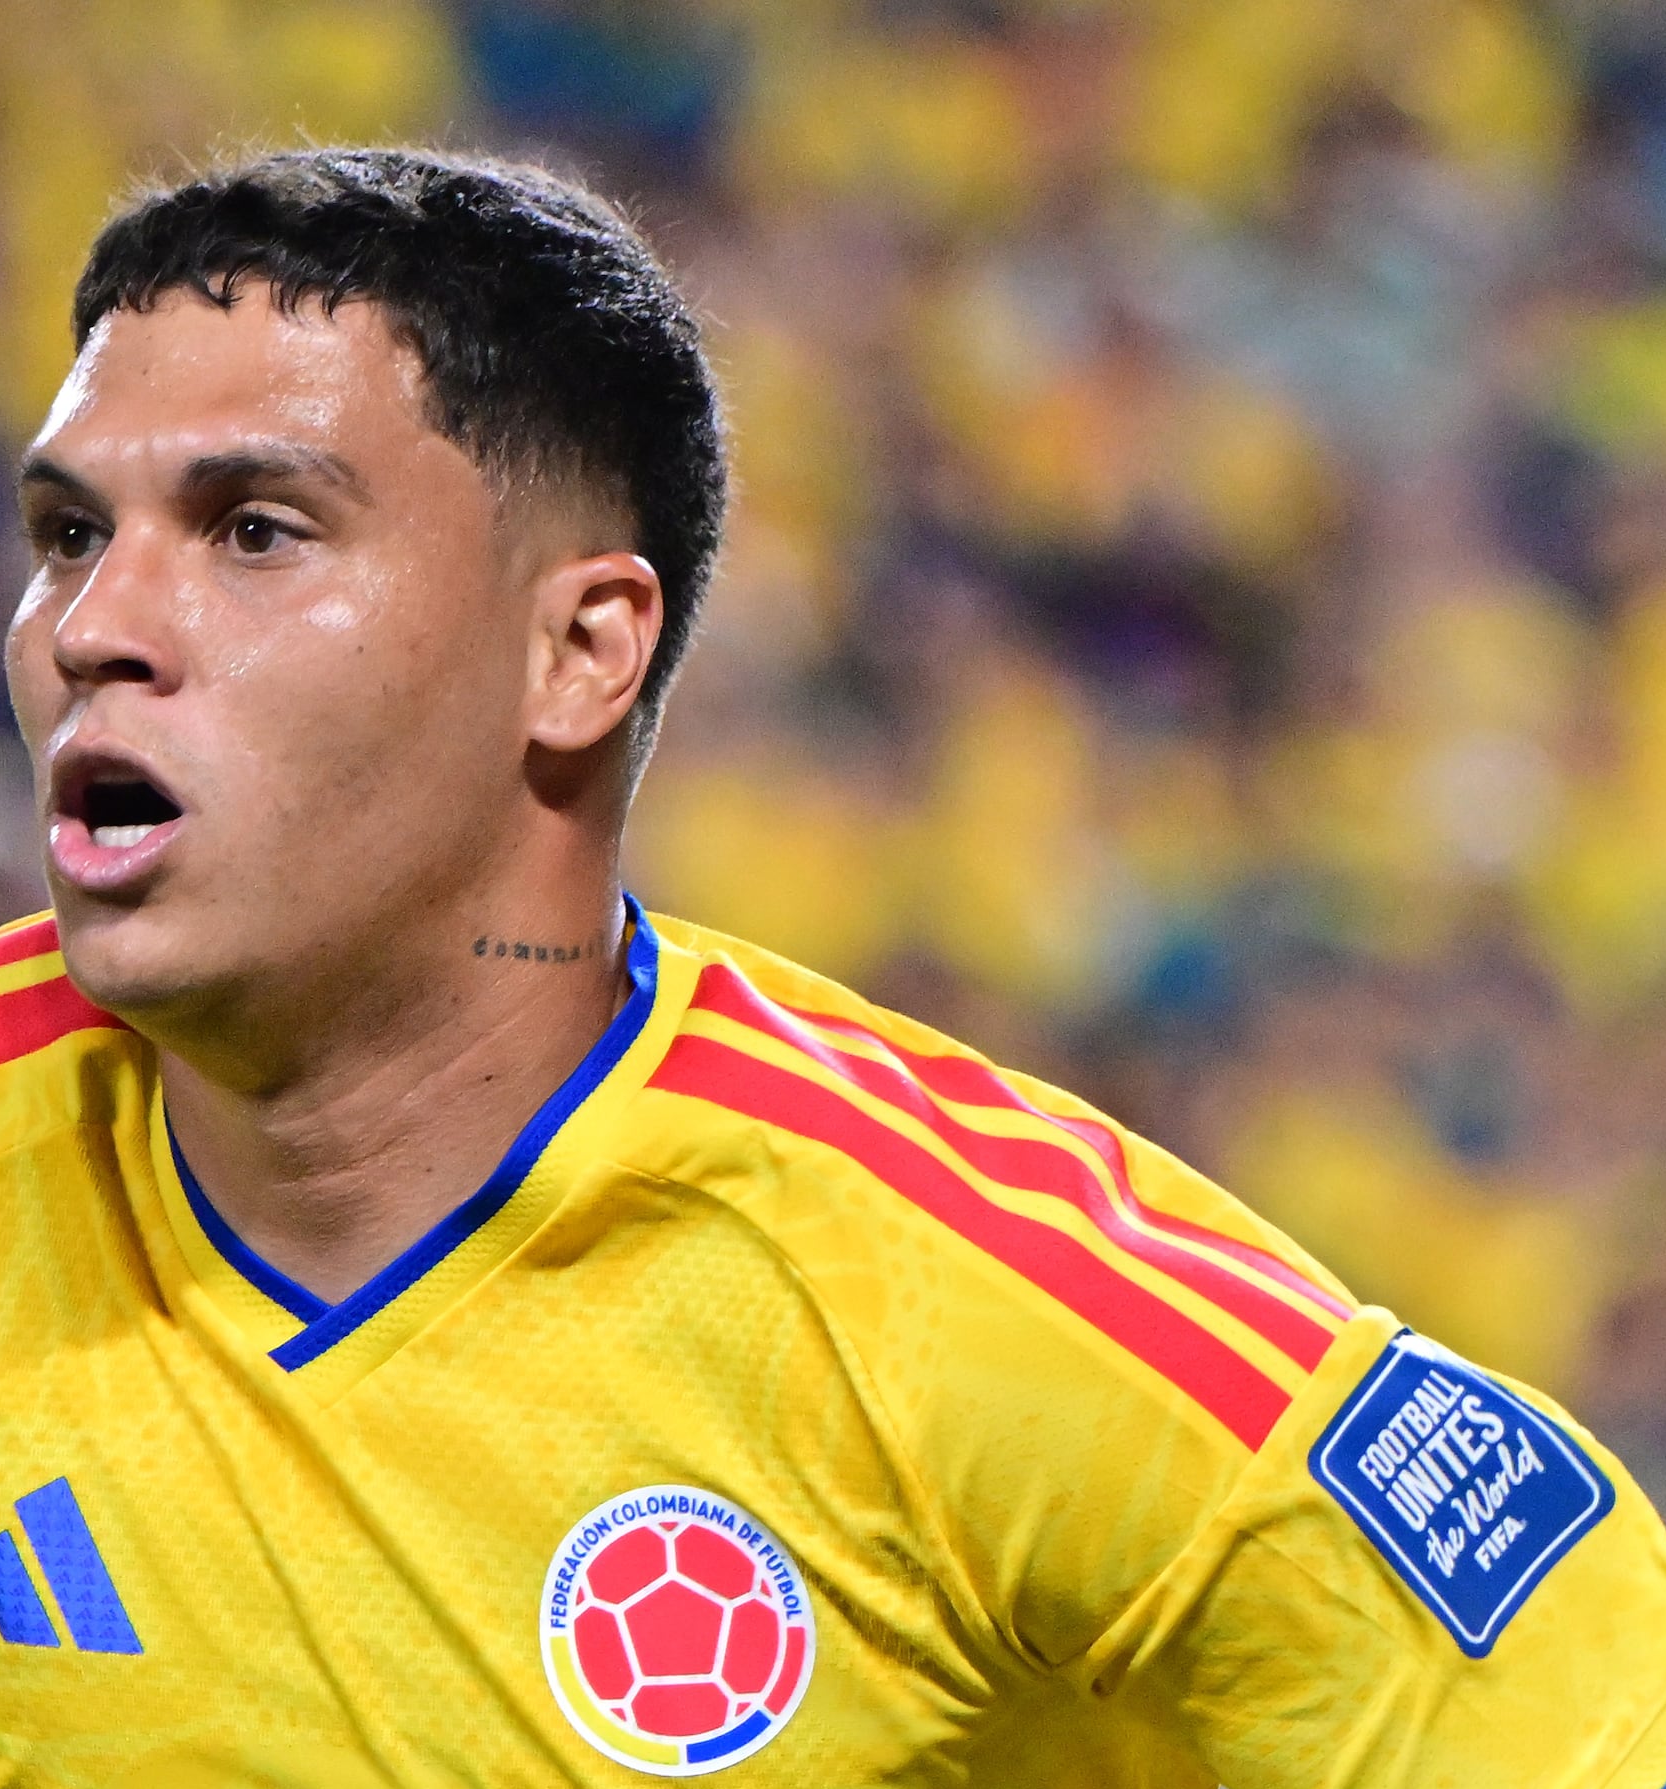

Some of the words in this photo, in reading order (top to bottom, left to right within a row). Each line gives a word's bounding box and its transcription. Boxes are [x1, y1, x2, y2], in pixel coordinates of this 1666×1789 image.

[1356, 1370, 1465, 1492] FOOTBALL
[1385, 1394, 1505, 1533] UNITES
[550, 1516, 612, 1629] FEDERACIÓN
[611, 1495, 735, 1532] COLOMBIANA
[737, 1522, 763, 1549] DE
[758, 1544, 803, 1621] FÚTBOL
[1426, 1527, 1465, 1579] the
[1451, 1428, 1545, 1537] World
[1474, 1515, 1528, 1572] FIFA
